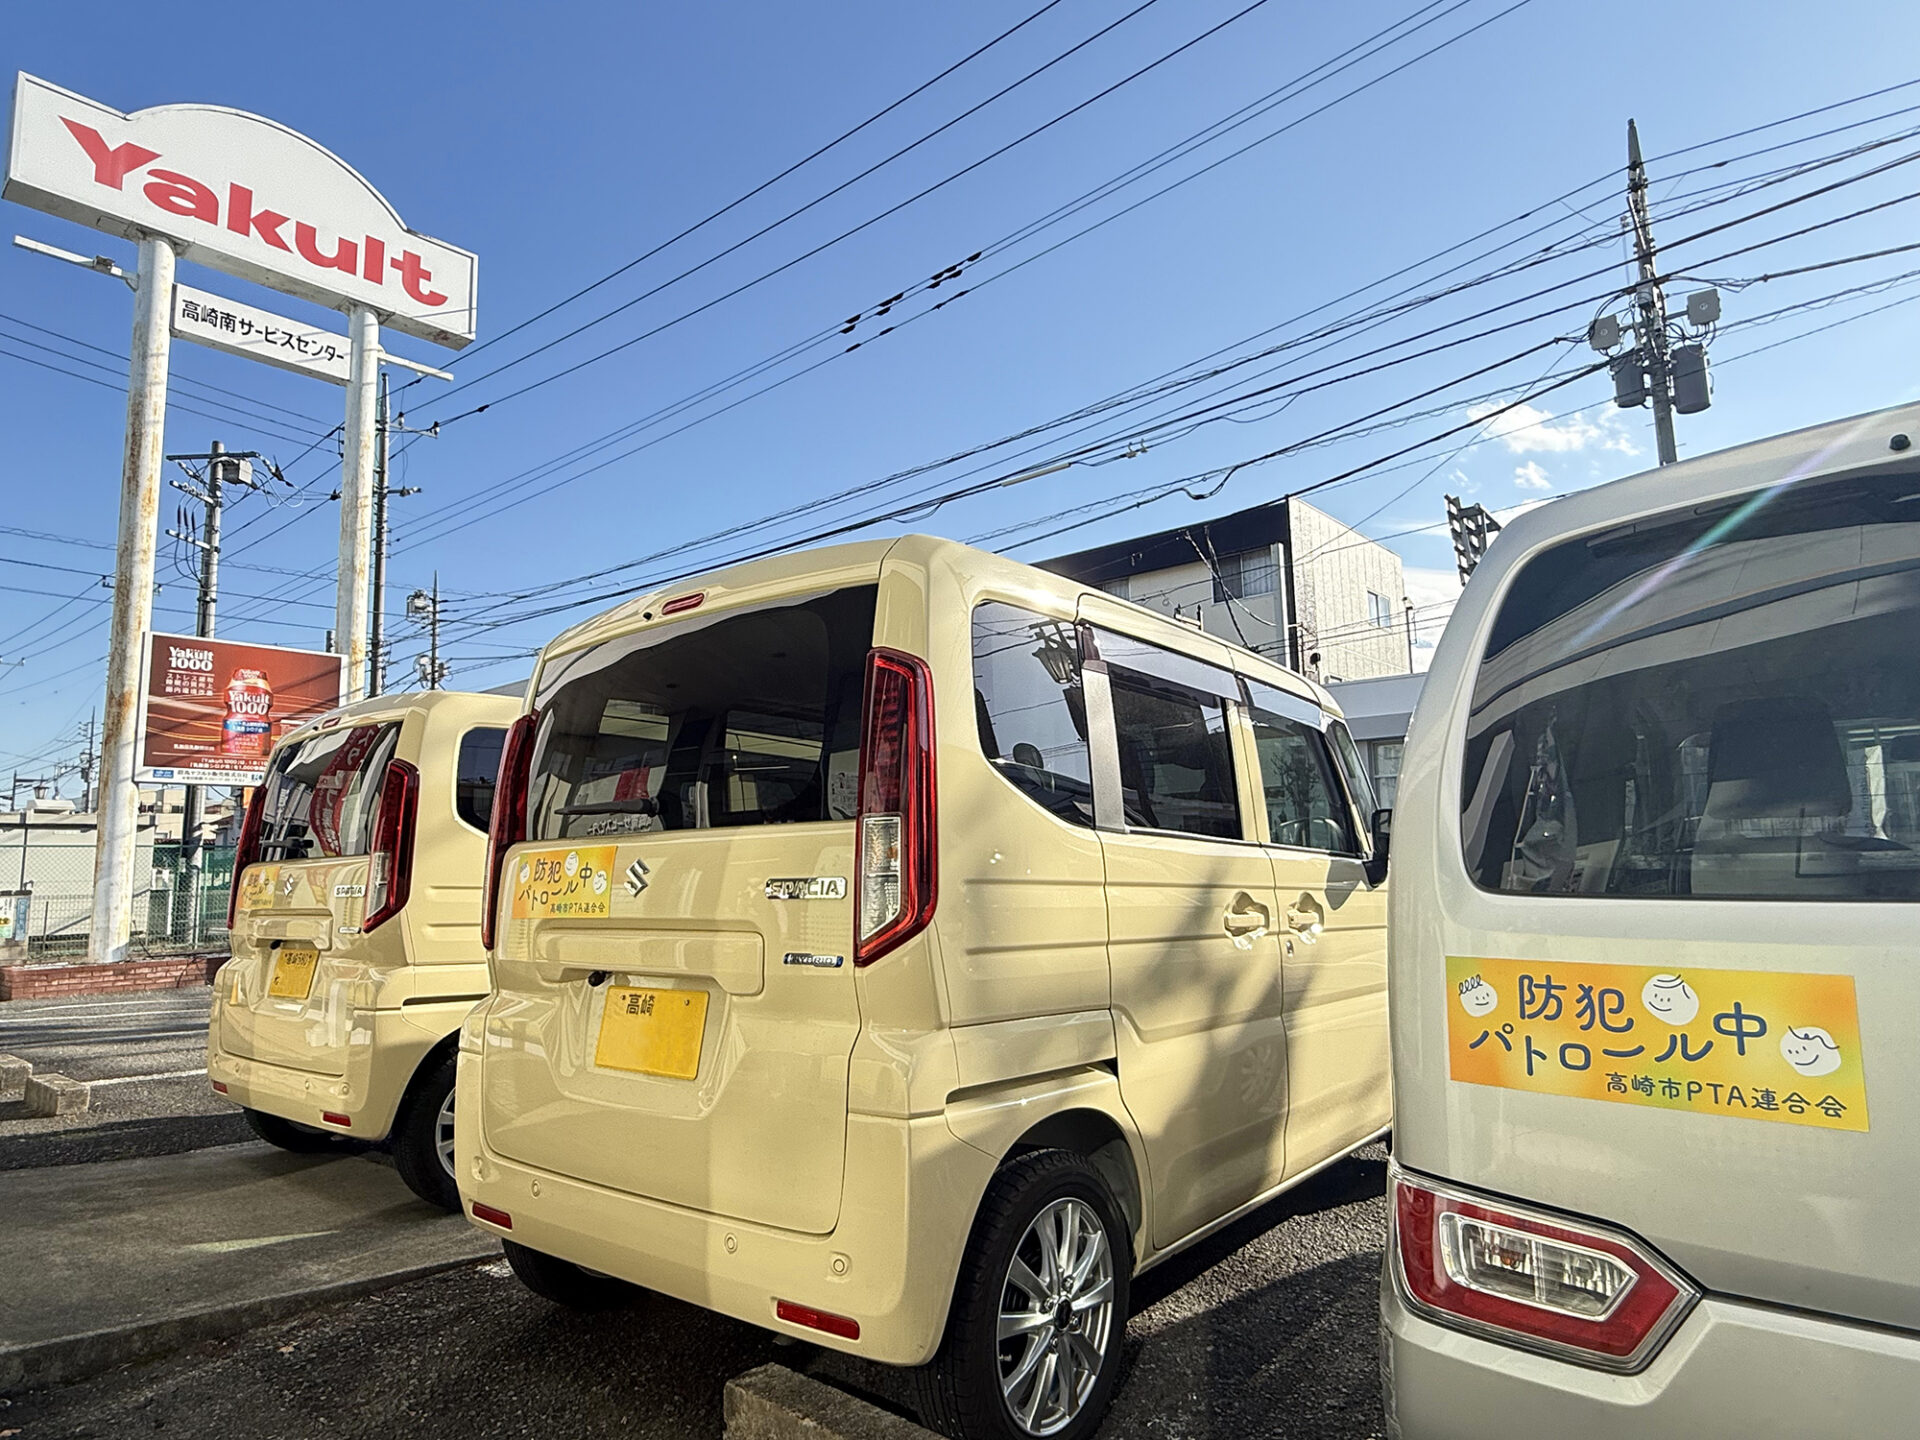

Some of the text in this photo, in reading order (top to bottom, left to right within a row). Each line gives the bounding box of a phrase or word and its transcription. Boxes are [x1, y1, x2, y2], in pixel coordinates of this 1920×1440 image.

[58, 114, 449, 307] Yakult
[182, 299, 345, 362] 高崎南サービスセンター
[168, 656, 213, 671] 1000
[169, 646, 214, 661] Yakult
[228, 690, 270, 704] Yakult
[228, 701, 268, 715] 1000
[533, 857, 562, 885] 防犯
[550, 902, 606, 914] 高崎市PTA連合会
[626, 994, 656, 1017] 高崎
[1517, 974, 1635, 1033] 防犯
[1604, 1071, 1848, 1119] 高崎市PTA連合会
